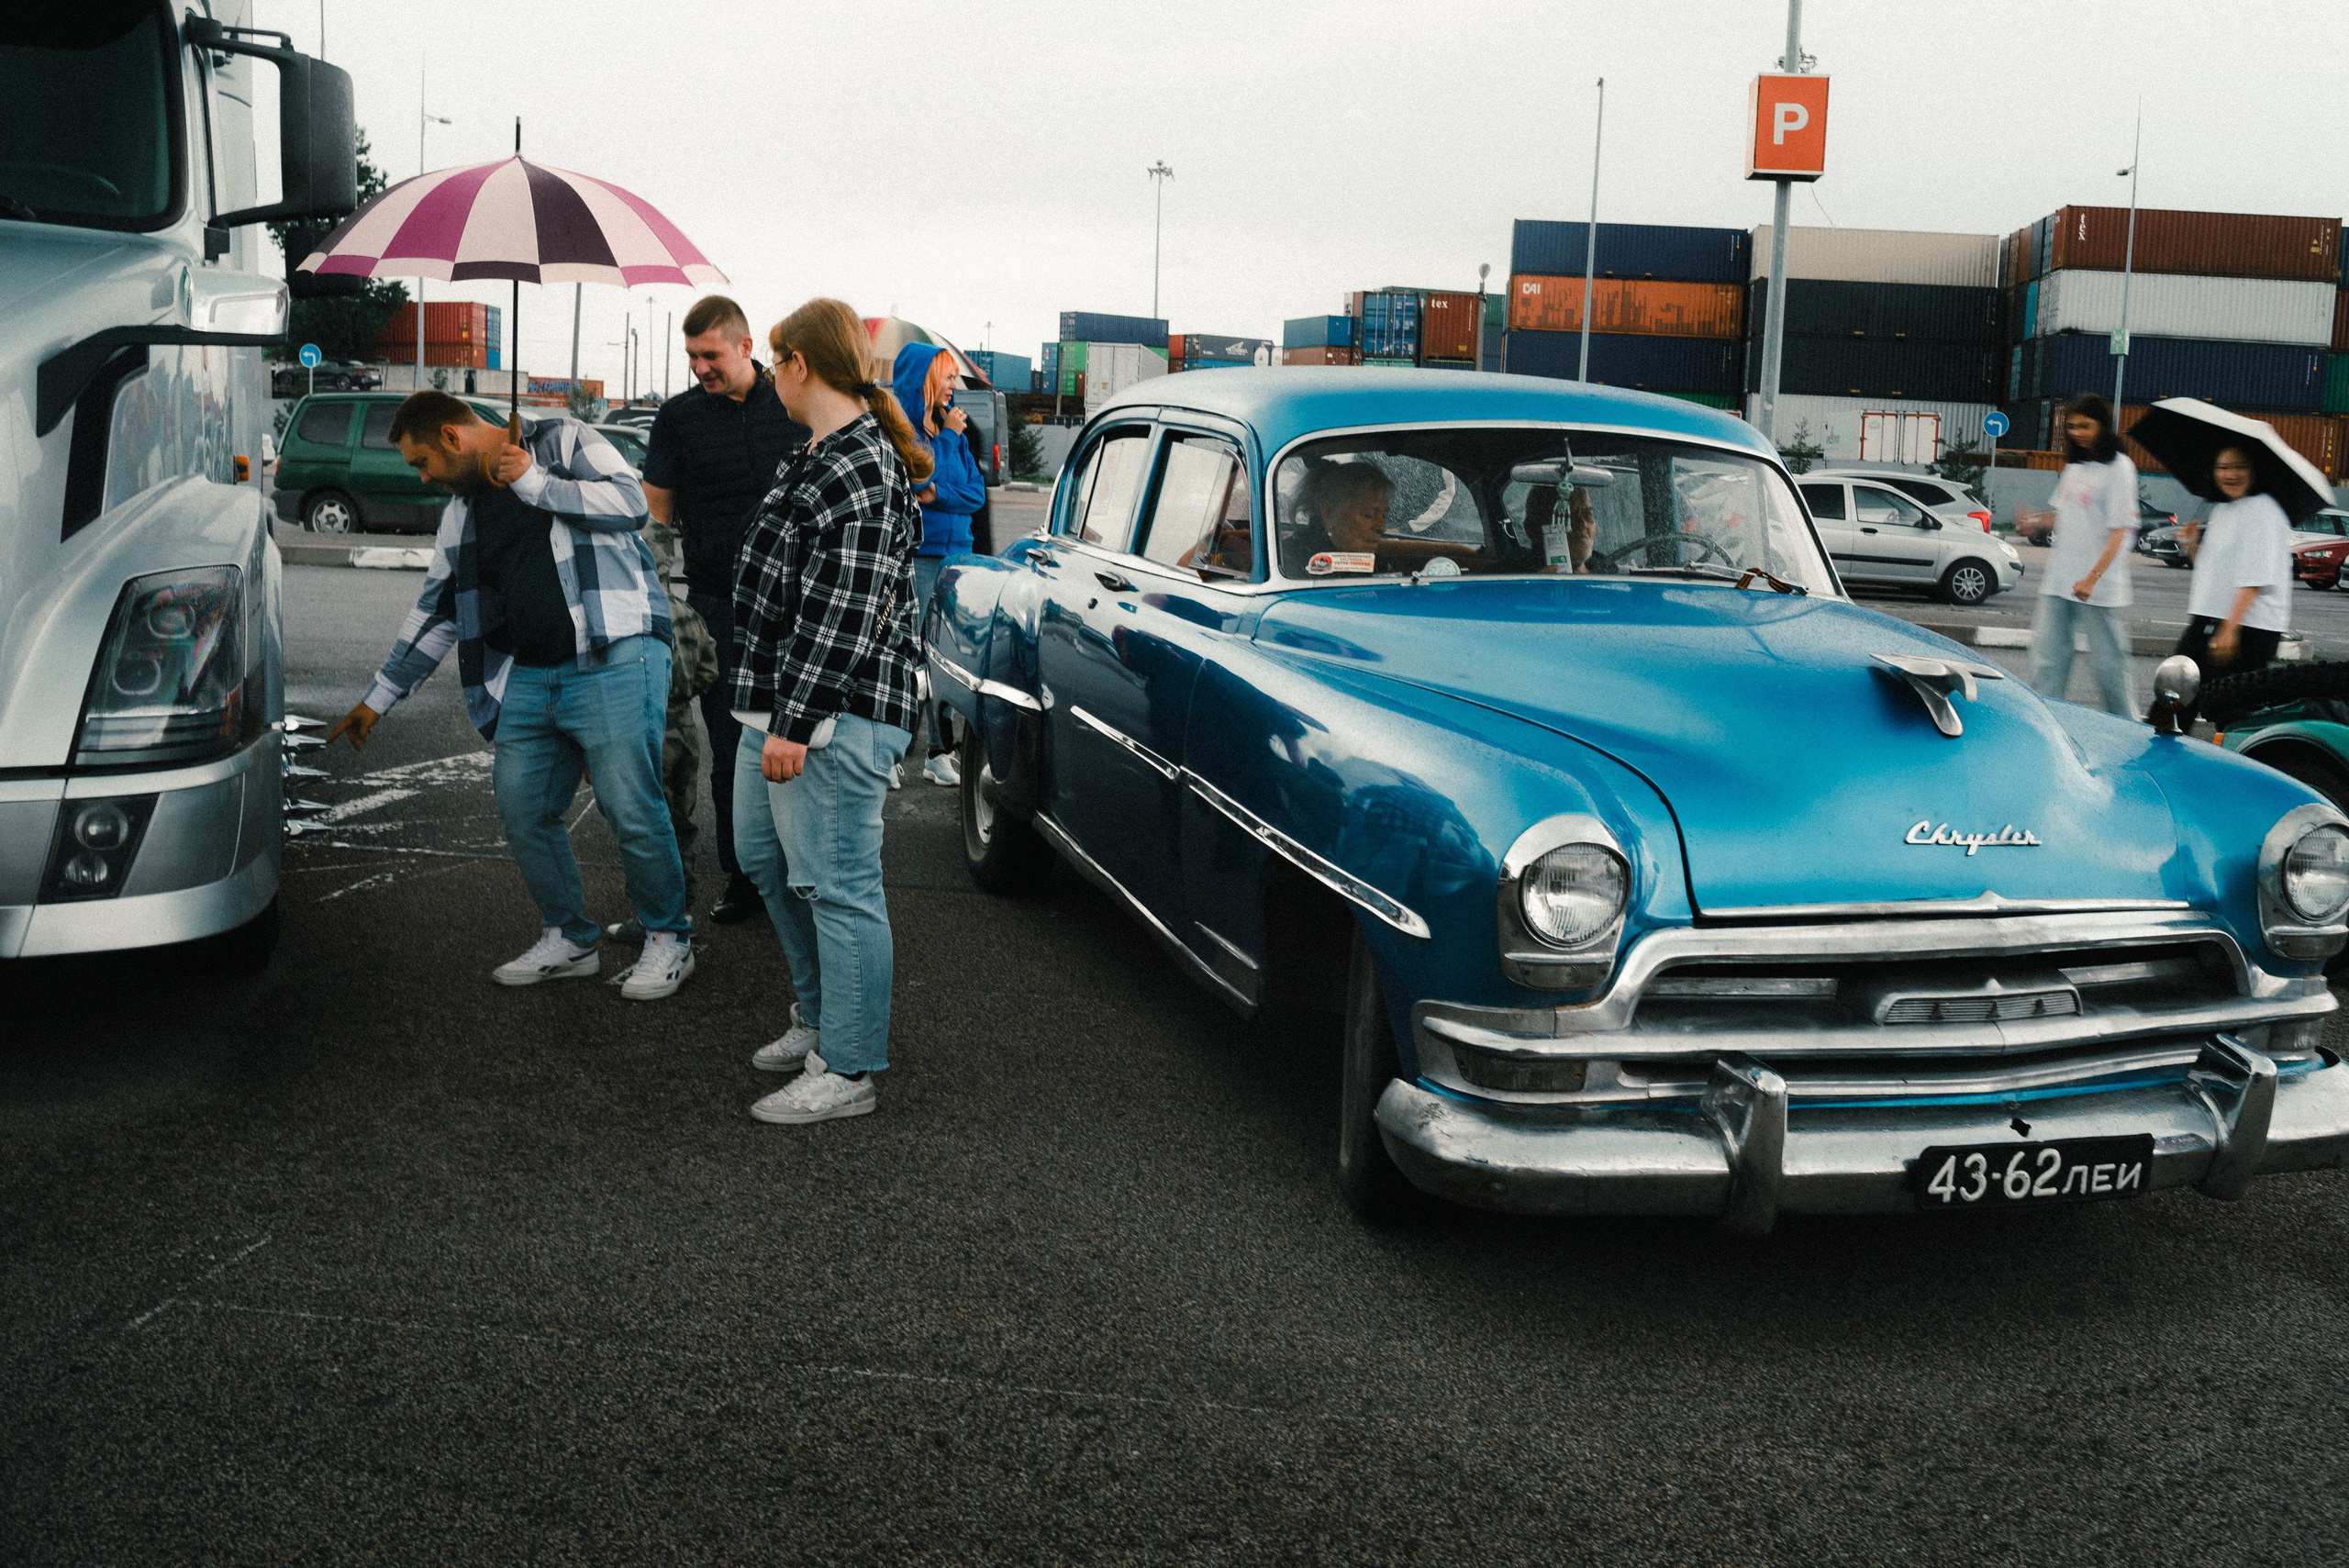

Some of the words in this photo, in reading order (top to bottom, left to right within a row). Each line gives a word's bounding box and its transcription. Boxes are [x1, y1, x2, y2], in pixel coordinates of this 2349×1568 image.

[1773, 102, 1809, 146] P
[1431, 298, 1449, 309] tex
[1905, 819, 2043, 856] Chrysler
[1927, 1147, 2062, 1203] 43-62
[2061, 1162, 2143, 1195] ЛЕИ
